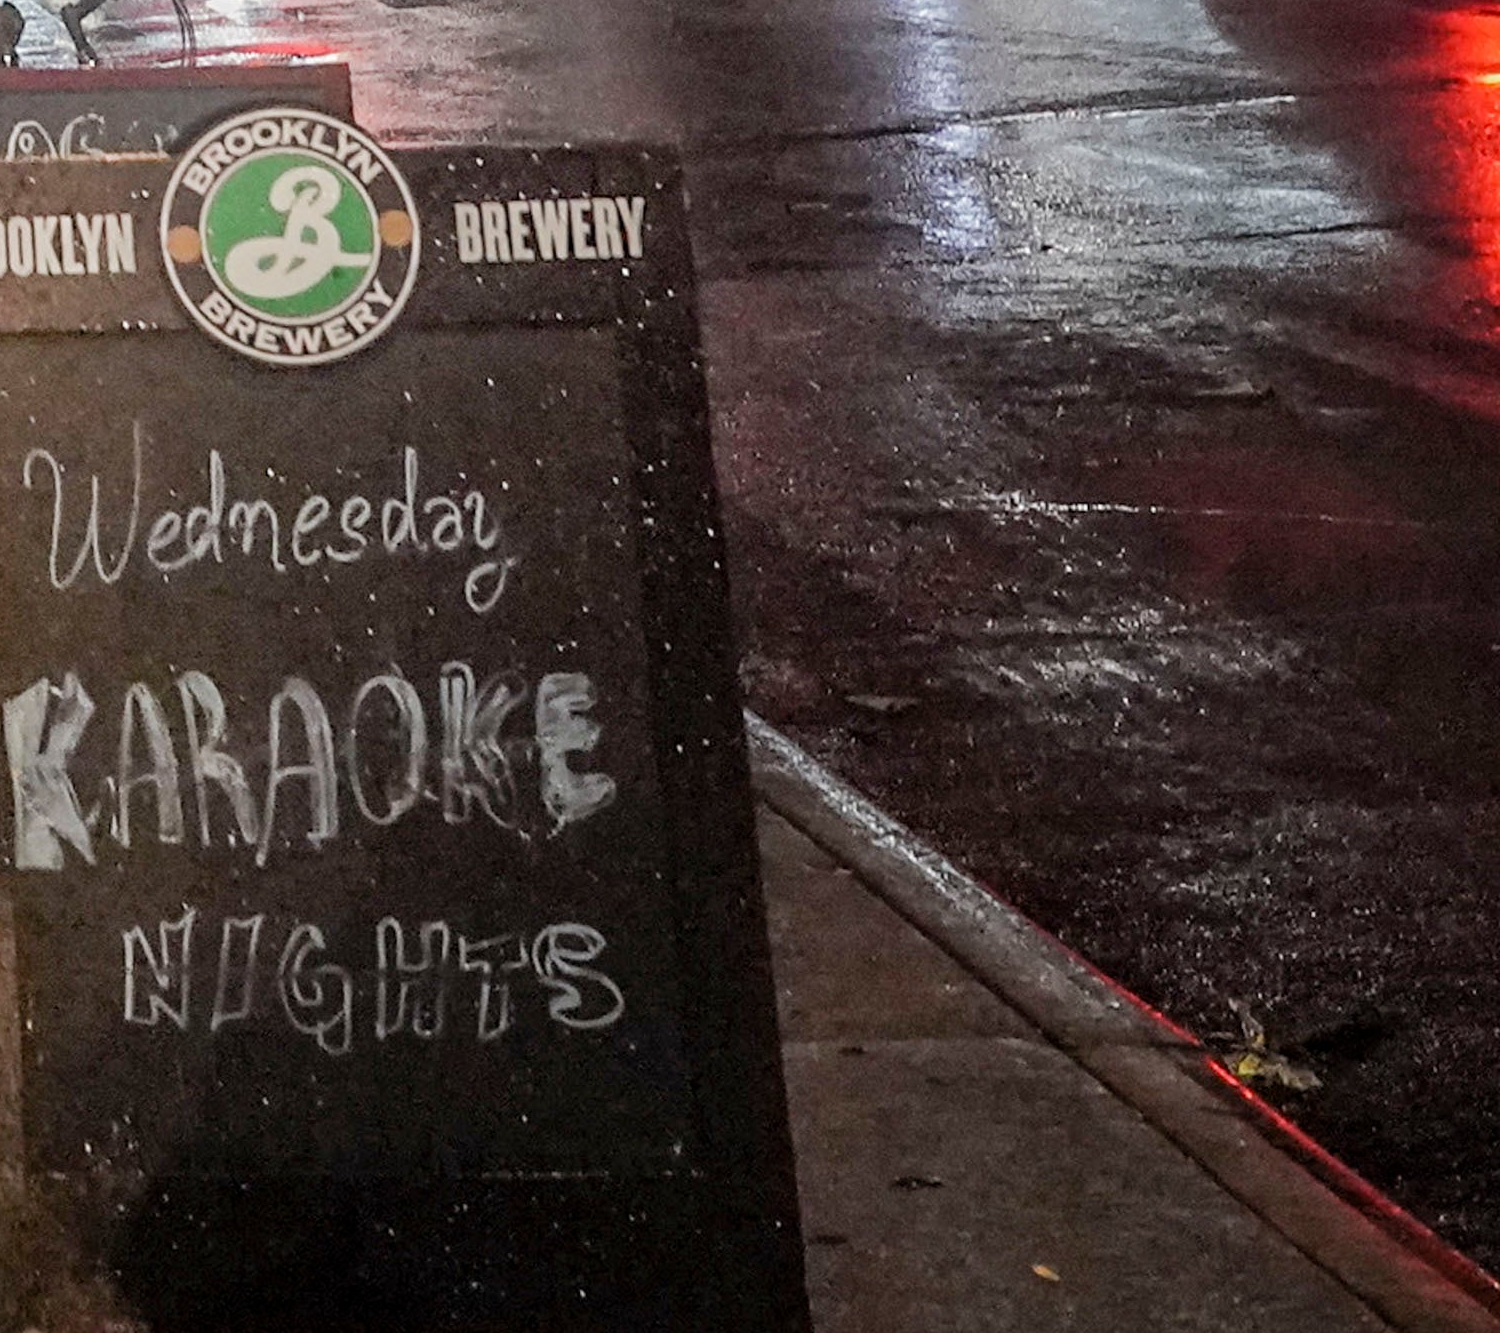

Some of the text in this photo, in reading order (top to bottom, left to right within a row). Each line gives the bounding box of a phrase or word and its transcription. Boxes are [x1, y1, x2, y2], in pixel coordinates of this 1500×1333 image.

[181, 117, 384, 199] BROOKLYN
[452, 195, 647, 265] BREWERY
[199, 279, 399, 357] BREWERY
[22, 419, 517, 613] Wednesday
[2, 660, 618, 871] KARAOKE
[122, 905, 626, 1056] NIGHTS
